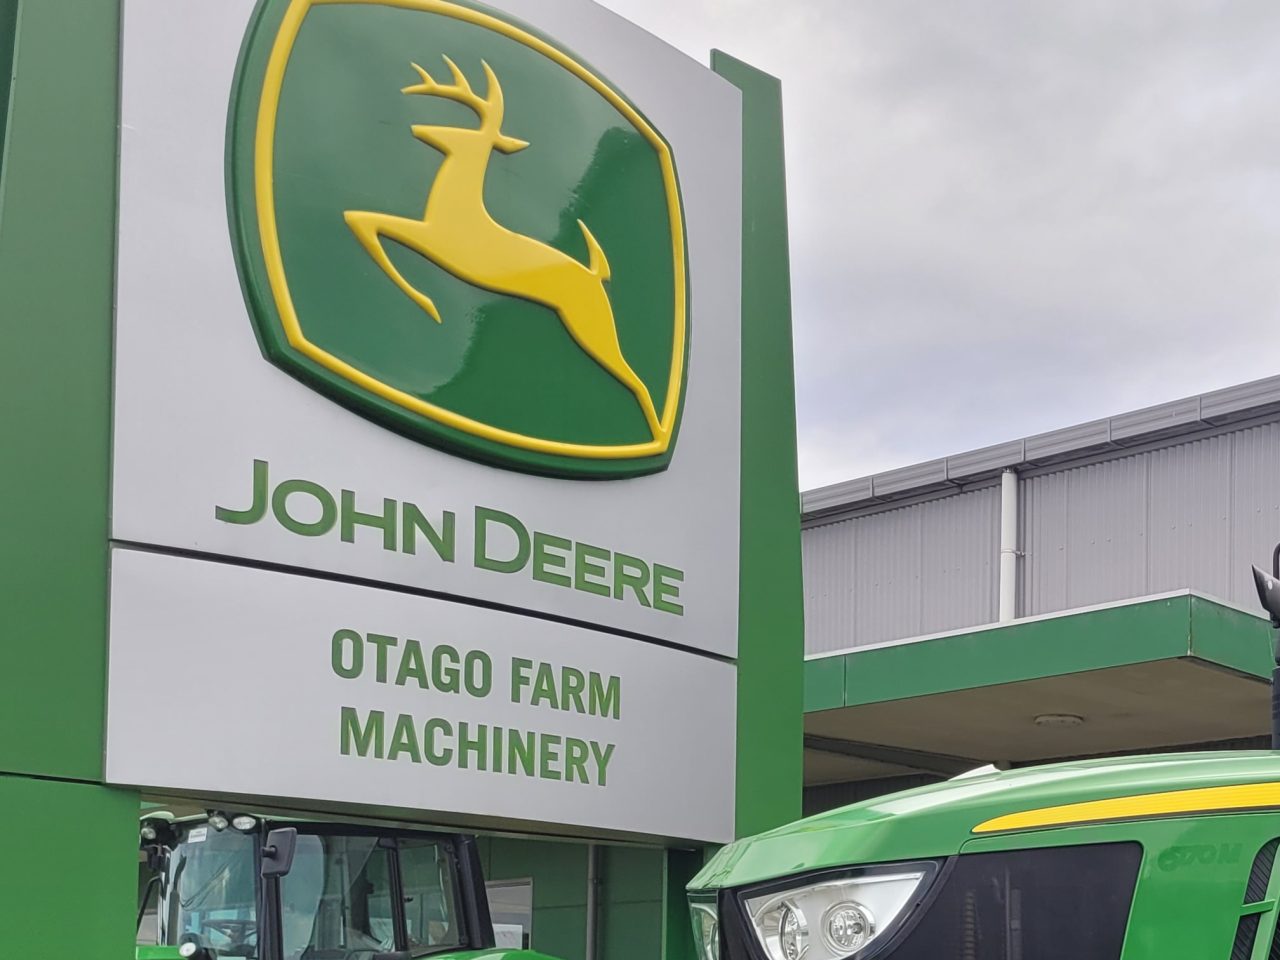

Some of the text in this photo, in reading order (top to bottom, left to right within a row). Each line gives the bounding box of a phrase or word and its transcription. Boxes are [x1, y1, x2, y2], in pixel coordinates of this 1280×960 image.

[215, 459, 685, 616] JOHN DEERE
[331, 628, 621, 720] OTAGO FARM
[339, 706, 616, 787] MACHINERY
